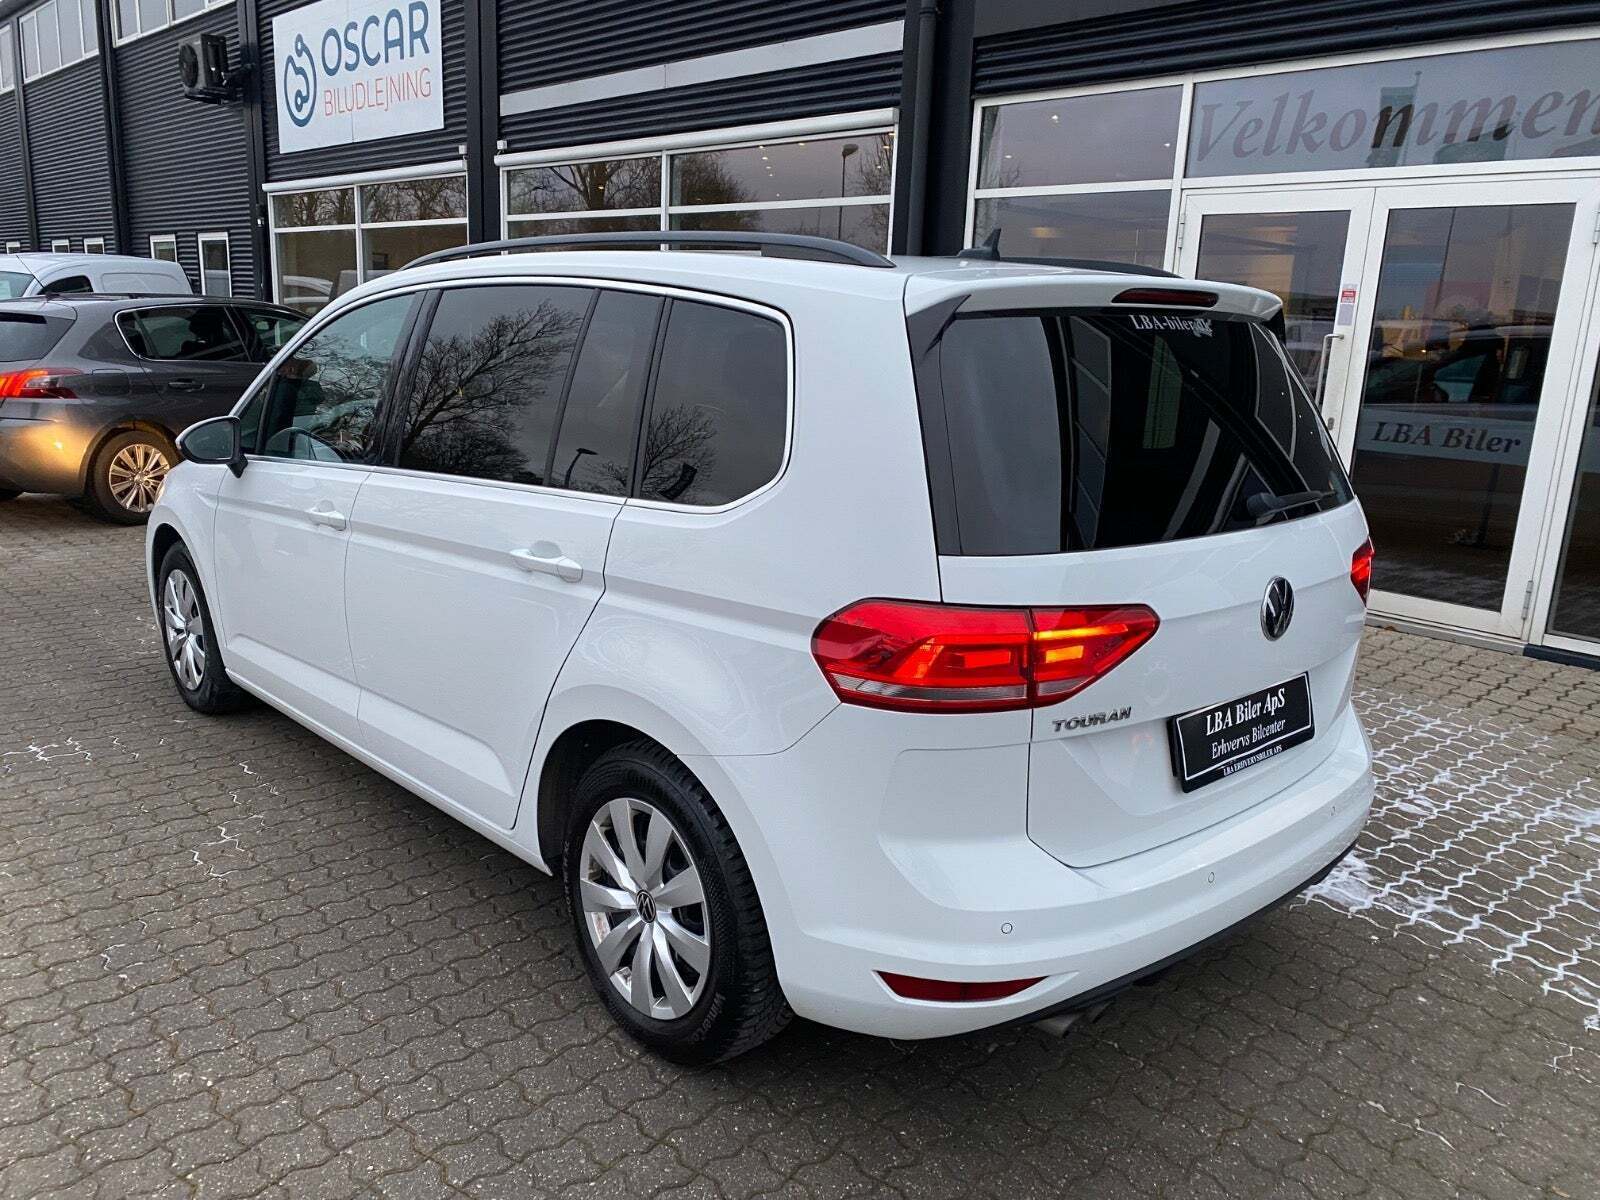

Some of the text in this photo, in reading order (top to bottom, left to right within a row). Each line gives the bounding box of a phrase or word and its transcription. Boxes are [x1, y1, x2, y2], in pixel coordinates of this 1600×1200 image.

[321, 1, 430, 77] OSCAR
[324, 67, 432, 117] BILUDLEJNING
[1196, 88, 1600, 162] Velkommen
[1371, 421, 1521, 453] LBA Biler
[1052, 706, 1132, 732] TOURAN
[1206, 687, 1285, 736] LBA Biler ApS
[1211, 719, 1286, 760] Erhvervs Bilcenter
